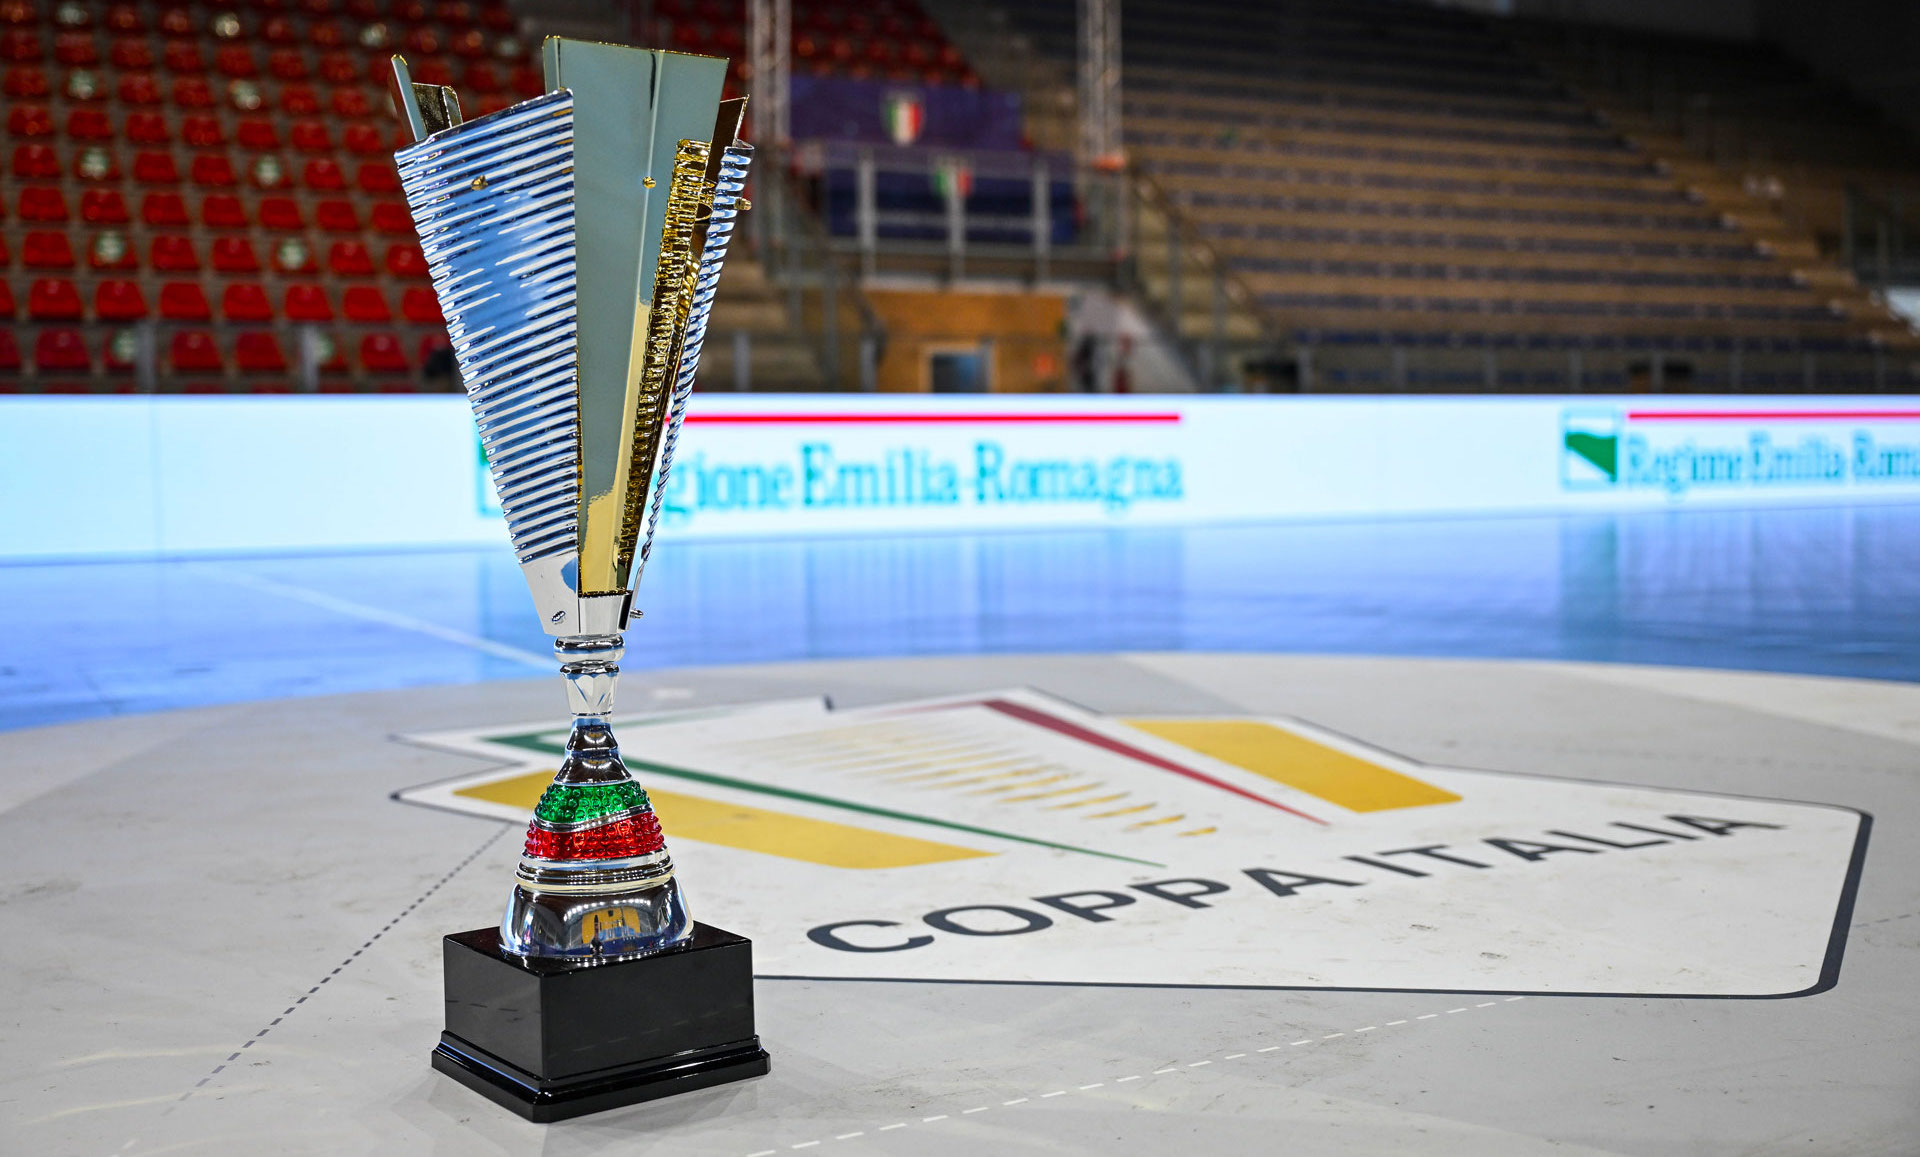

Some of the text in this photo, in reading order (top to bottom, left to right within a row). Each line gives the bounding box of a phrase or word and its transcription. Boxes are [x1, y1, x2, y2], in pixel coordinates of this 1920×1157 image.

[662, 440, 1186, 527] gione Emilia-Romagna
[806, 814, 1788, 953] COPPA ITALIA
